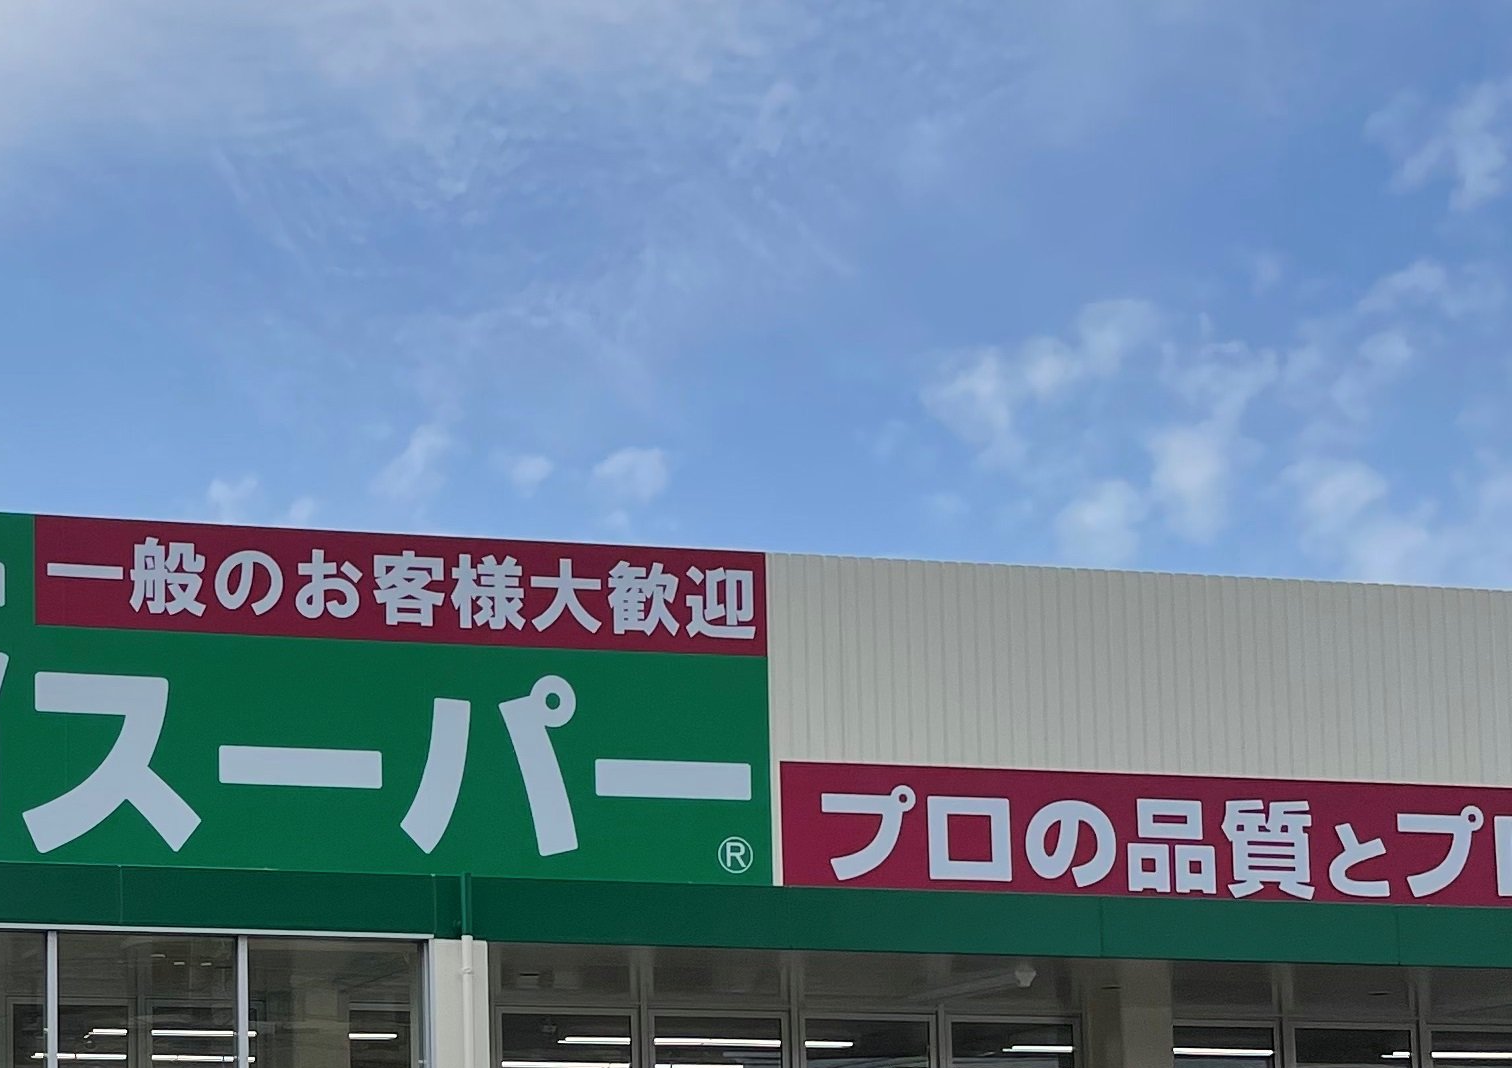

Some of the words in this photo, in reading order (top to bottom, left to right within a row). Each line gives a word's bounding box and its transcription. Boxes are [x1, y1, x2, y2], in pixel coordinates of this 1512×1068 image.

[46, 536, 756, 641] 一般のお客様大歓迎
[821, 784, 1512, 900] プロの品質とプ
